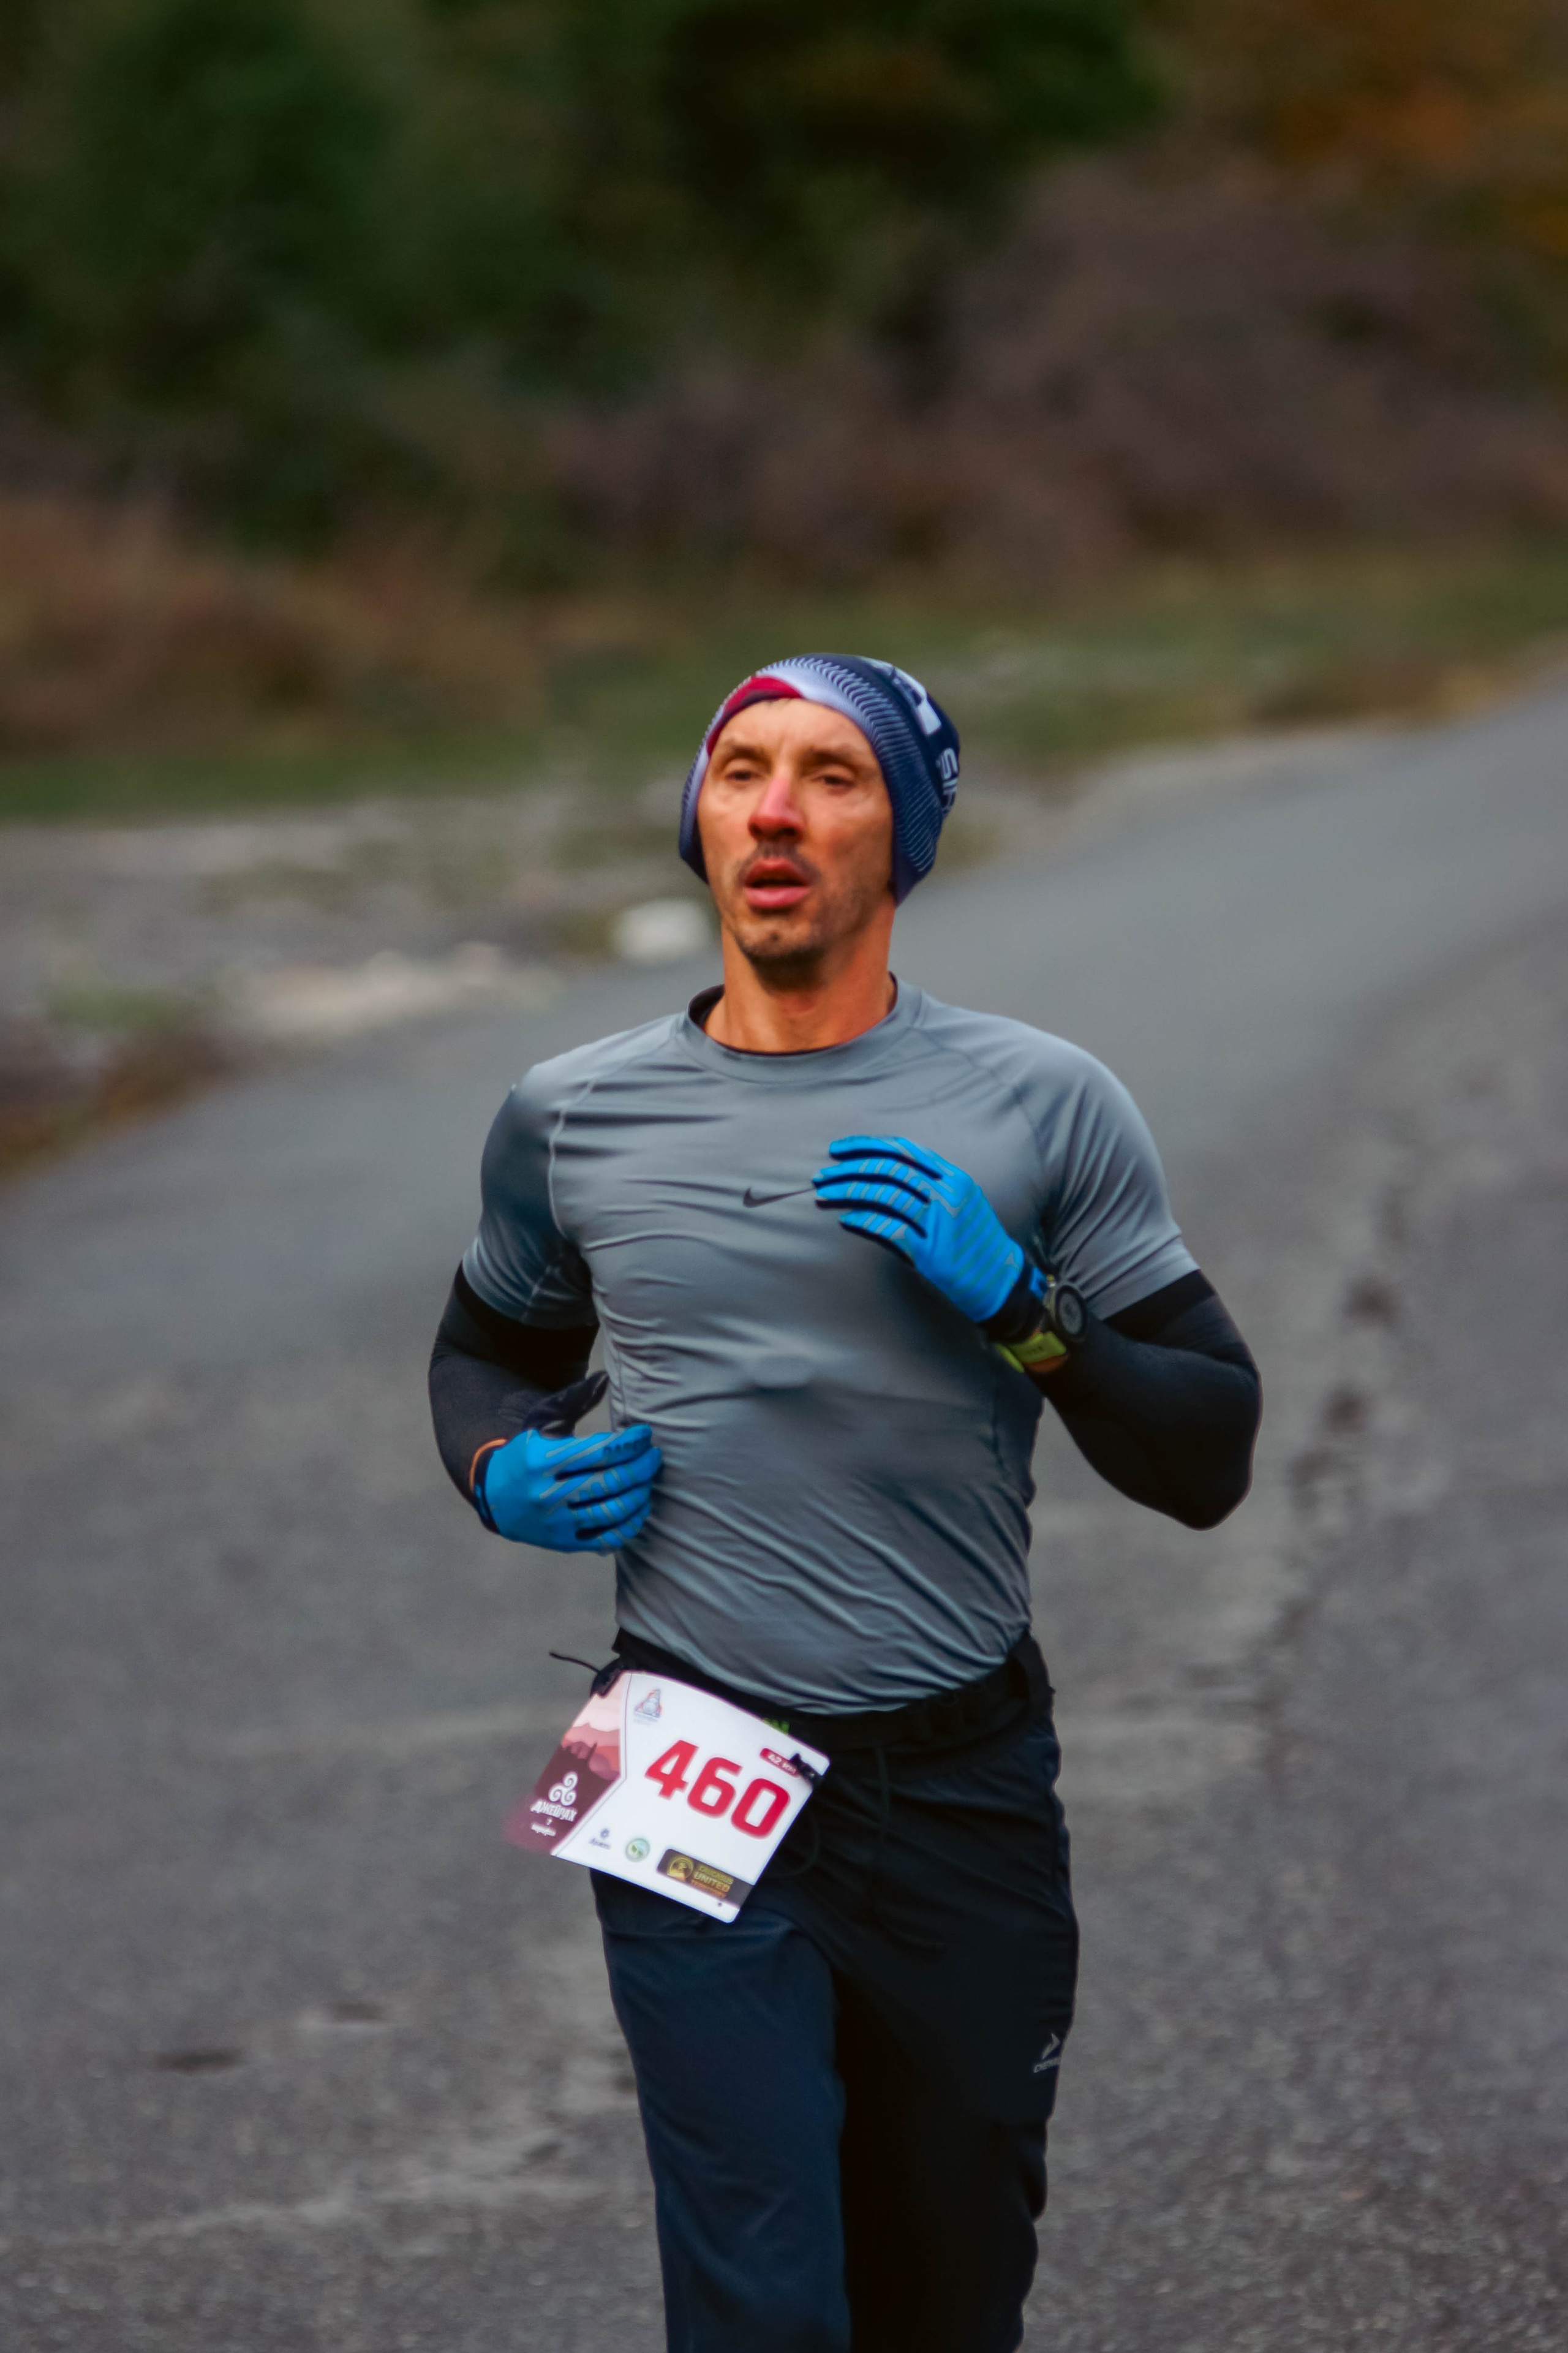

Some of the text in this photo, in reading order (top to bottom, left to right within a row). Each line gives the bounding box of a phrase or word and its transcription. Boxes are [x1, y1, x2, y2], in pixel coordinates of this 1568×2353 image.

[767, 1754, 782, 1765] 42
[644, 1739, 791, 1840] 460
[694, 1871, 731, 1892] UNITED
